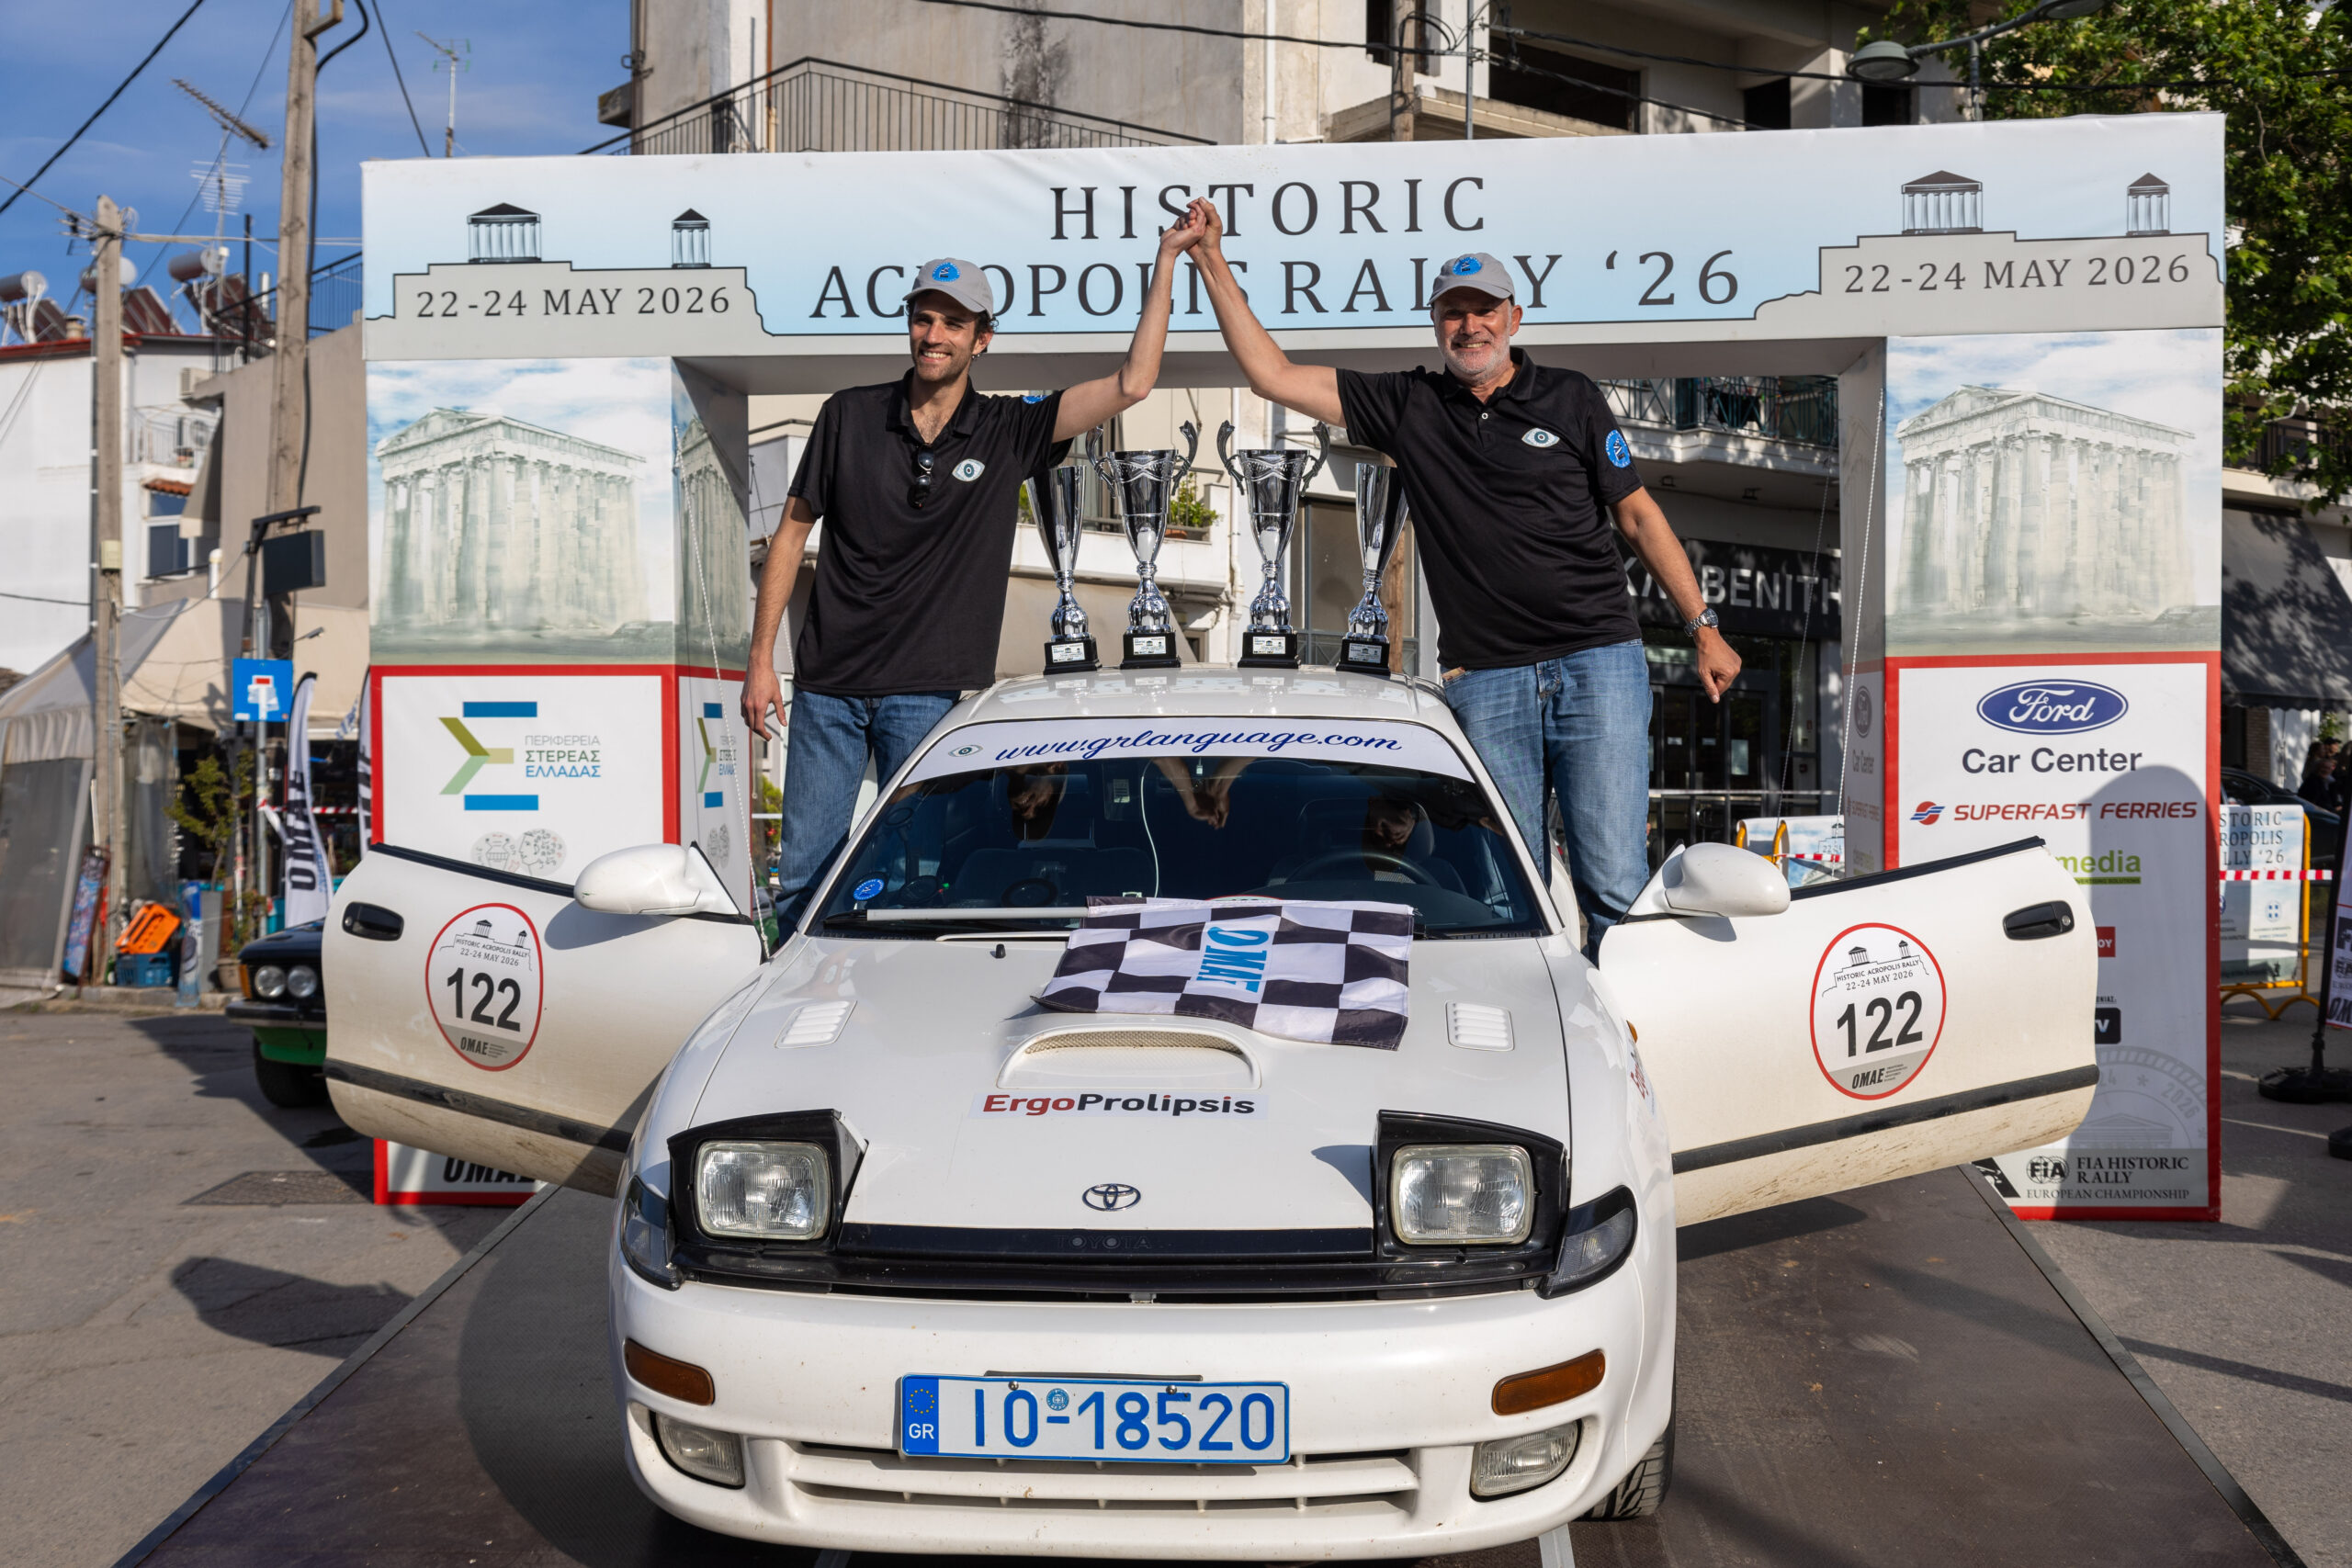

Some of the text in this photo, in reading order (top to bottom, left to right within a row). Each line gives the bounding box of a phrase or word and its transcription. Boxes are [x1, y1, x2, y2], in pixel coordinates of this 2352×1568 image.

[1049, 176, 1485, 240] HISTORIC
[1281, 254, 1562, 314] RALY
[1844, 254, 2189, 294] 22-24 MAY 2026
[416, 286, 730, 318] 22-24 MAY 2026
[2008, 688, 2096, 723] Ford
[525, 735, 601, 746] ΠΕΡΙΦΕΡΕΙΑ
[995, 729, 1403, 761] www.grlanguage.com
[525, 750, 601, 762] ΣΤΕΡΕΑΣ
[1962, 747, 2143, 773] Car Center
[526, 765, 602, 777] ΕΛΛΑΔΑΣ
[1953, 801, 2198, 821] SUPERFAST FERRIES
[2220, 811, 2282, 828] STORIC
[2220, 829, 2283, 846] ROPOLIS
[2223, 850, 2252, 865] LLY
[456, 938, 528, 958] HISTORIC ACROPOLIS RALLY
[459, 947, 519, 966] 22-24 MAY 2026
[1837, 959, 1919, 982] HISTORIC ACROPOLIS RALLY
[1846, 969, 1914, 991] 22-24 MAY 2026
[447, 967, 521, 1032] 122
[1837, 990, 1923, 1058] 122
[460, 1036, 489, 1056] OMAE
[1851, 1067, 1885, 1089] OMAE
[982, 1093, 1256, 1117] ErgoProlipsis
[2076, 1156, 2104, 1170] FIA
[2108, 1156, 2189, 1170] HISTORIC
[2076, 1171, 2133, 1184] RALLY
[2026, 1189, 2190, 1200] EUROPEAN CHAMPIONSHIP
[1050, 1235, 1153, 1250] TOYOTA
[908, 1423, 935, 1440] GR
